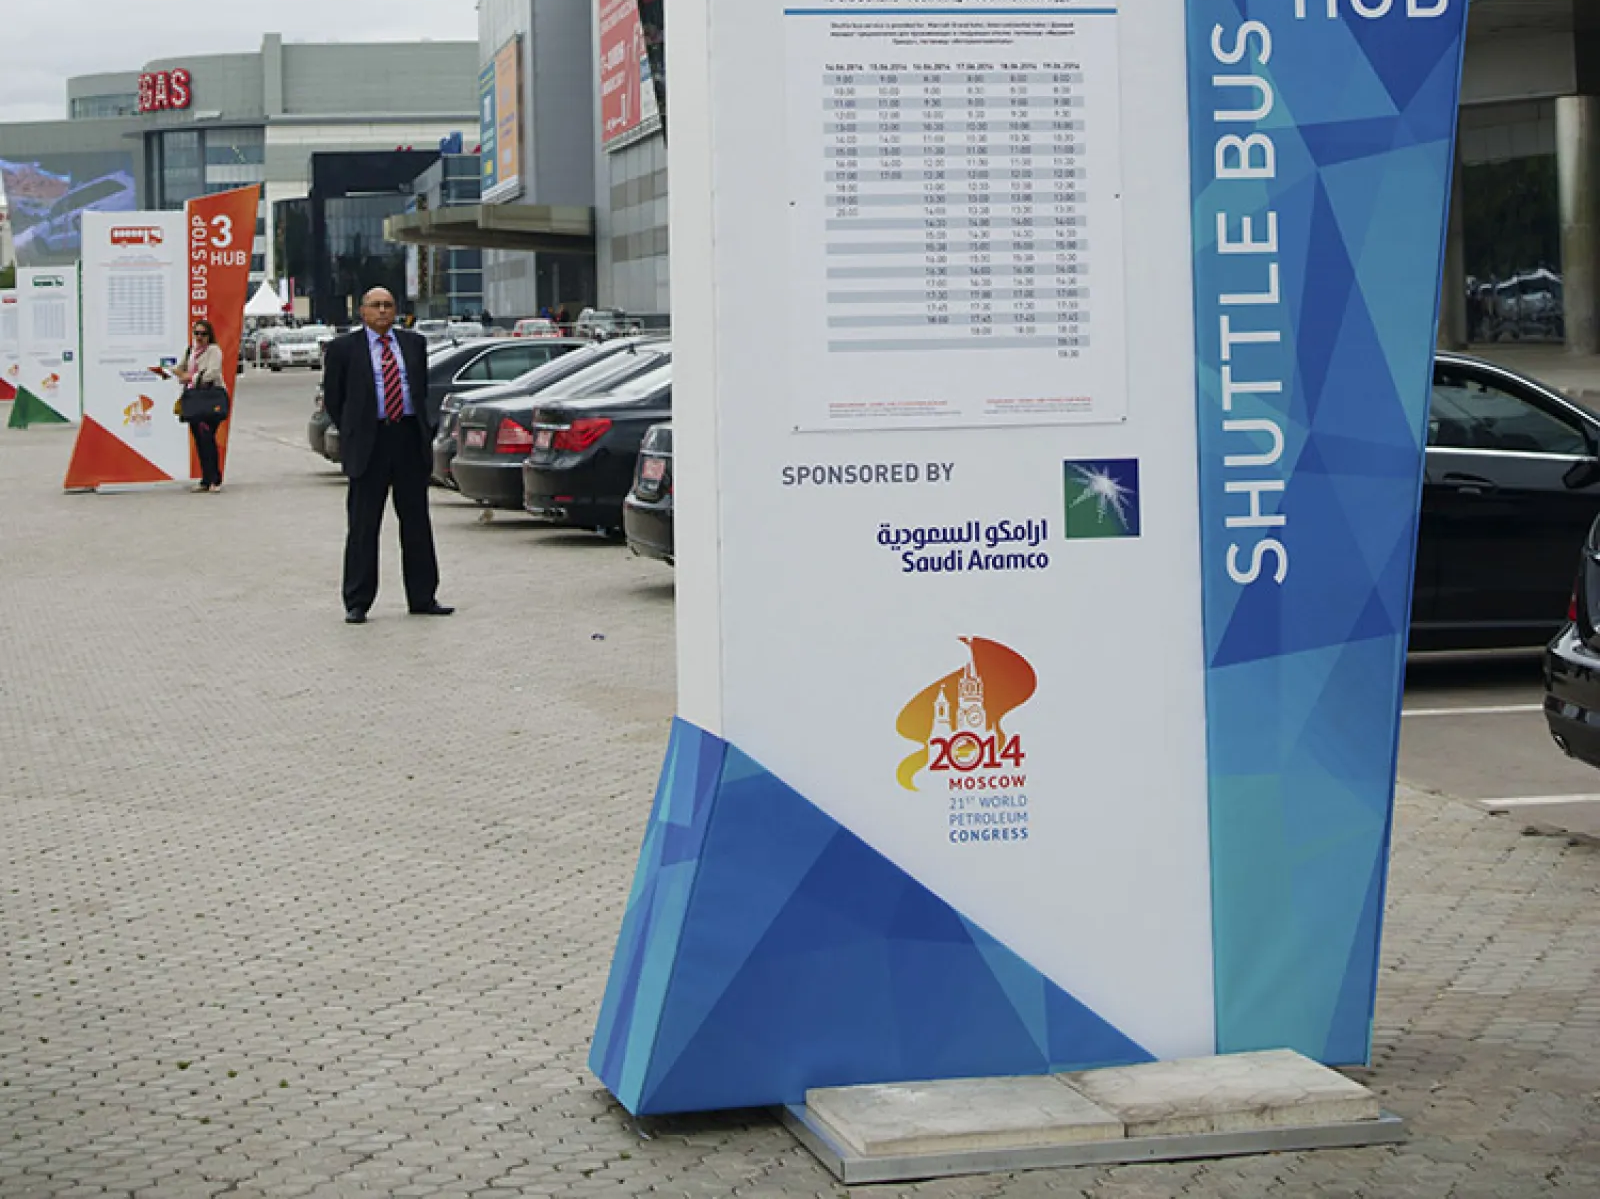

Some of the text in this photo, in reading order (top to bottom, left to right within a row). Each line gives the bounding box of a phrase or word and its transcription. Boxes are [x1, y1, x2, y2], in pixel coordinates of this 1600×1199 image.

[1211, 19, 1276, 180] BUS
[192, 214, 208, 261] STOP
[210, 214, 233, 248] 3
[210, 251, 246, 266] HUB
[192, 264, 208, 300] BUS
[1217, 211, 1288, 585] SHUTTLE
[782, 462, 955, 485] SPONSORED BY
[901, 548, 1049, 573] Saudi Aramco
[929, 731, 1026, 772] 2014
[948, 775, 1027, 790] MOSCOW
[978, 794, 1027, 808] WORLD
[948, 811, 1028, 827] PETROLEUM
[948, 827, 1029, 843] CONGRESS
